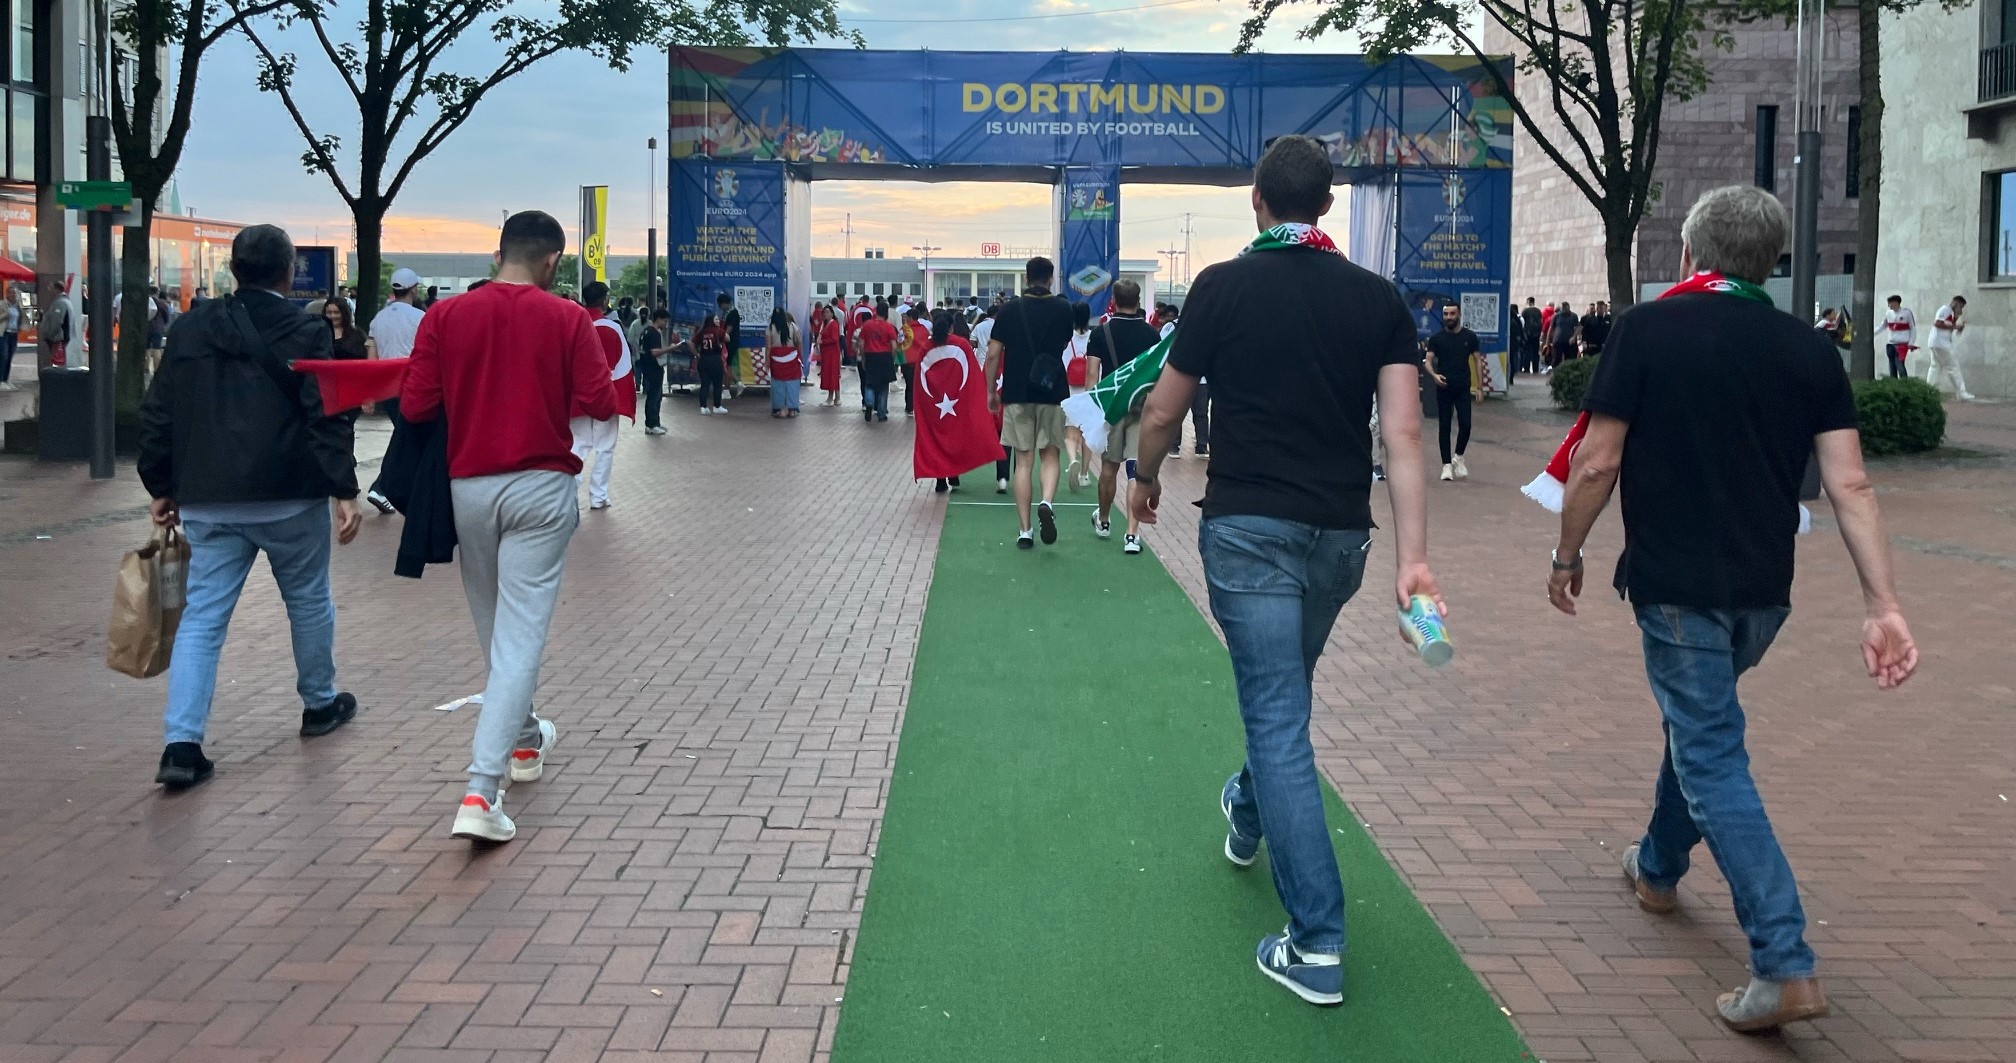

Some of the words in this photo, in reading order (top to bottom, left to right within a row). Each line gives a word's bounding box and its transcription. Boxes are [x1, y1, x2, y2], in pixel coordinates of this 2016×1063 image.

[962, 83, 1226, 114] DORTMUND
[986, 121, 1003, 134] IS
[1006, 122, 1073, 135] UNITED
[1076, 122, 1101, 135] BY
[1104, 123, 1200, 136] FOOTBALL
[697, 226, 734, 235] WATCH
[737, 227, 757, 235] THE
[696, 236, 731, 244] MATCH
[732, 236, 757, 244] LIVE
[694, 245, 714, 253] THE
[715, 245, 775, 254] DORTMUND
[984, 244, 998, 254] DB
[1423, 243, 1442, 251] THE
[682, 254, 719, 262] PUBLIC
[721, 254, 771, 263] VIEWING!
[1433, 252, 1475, 260] UNLOCK
[1420, 261, 1446, 269] FREE
[1448, 262, 1487, 270] TRAVEL
[703, 339, 713, 350] 21
[1273, 945, 1288, 967] N
